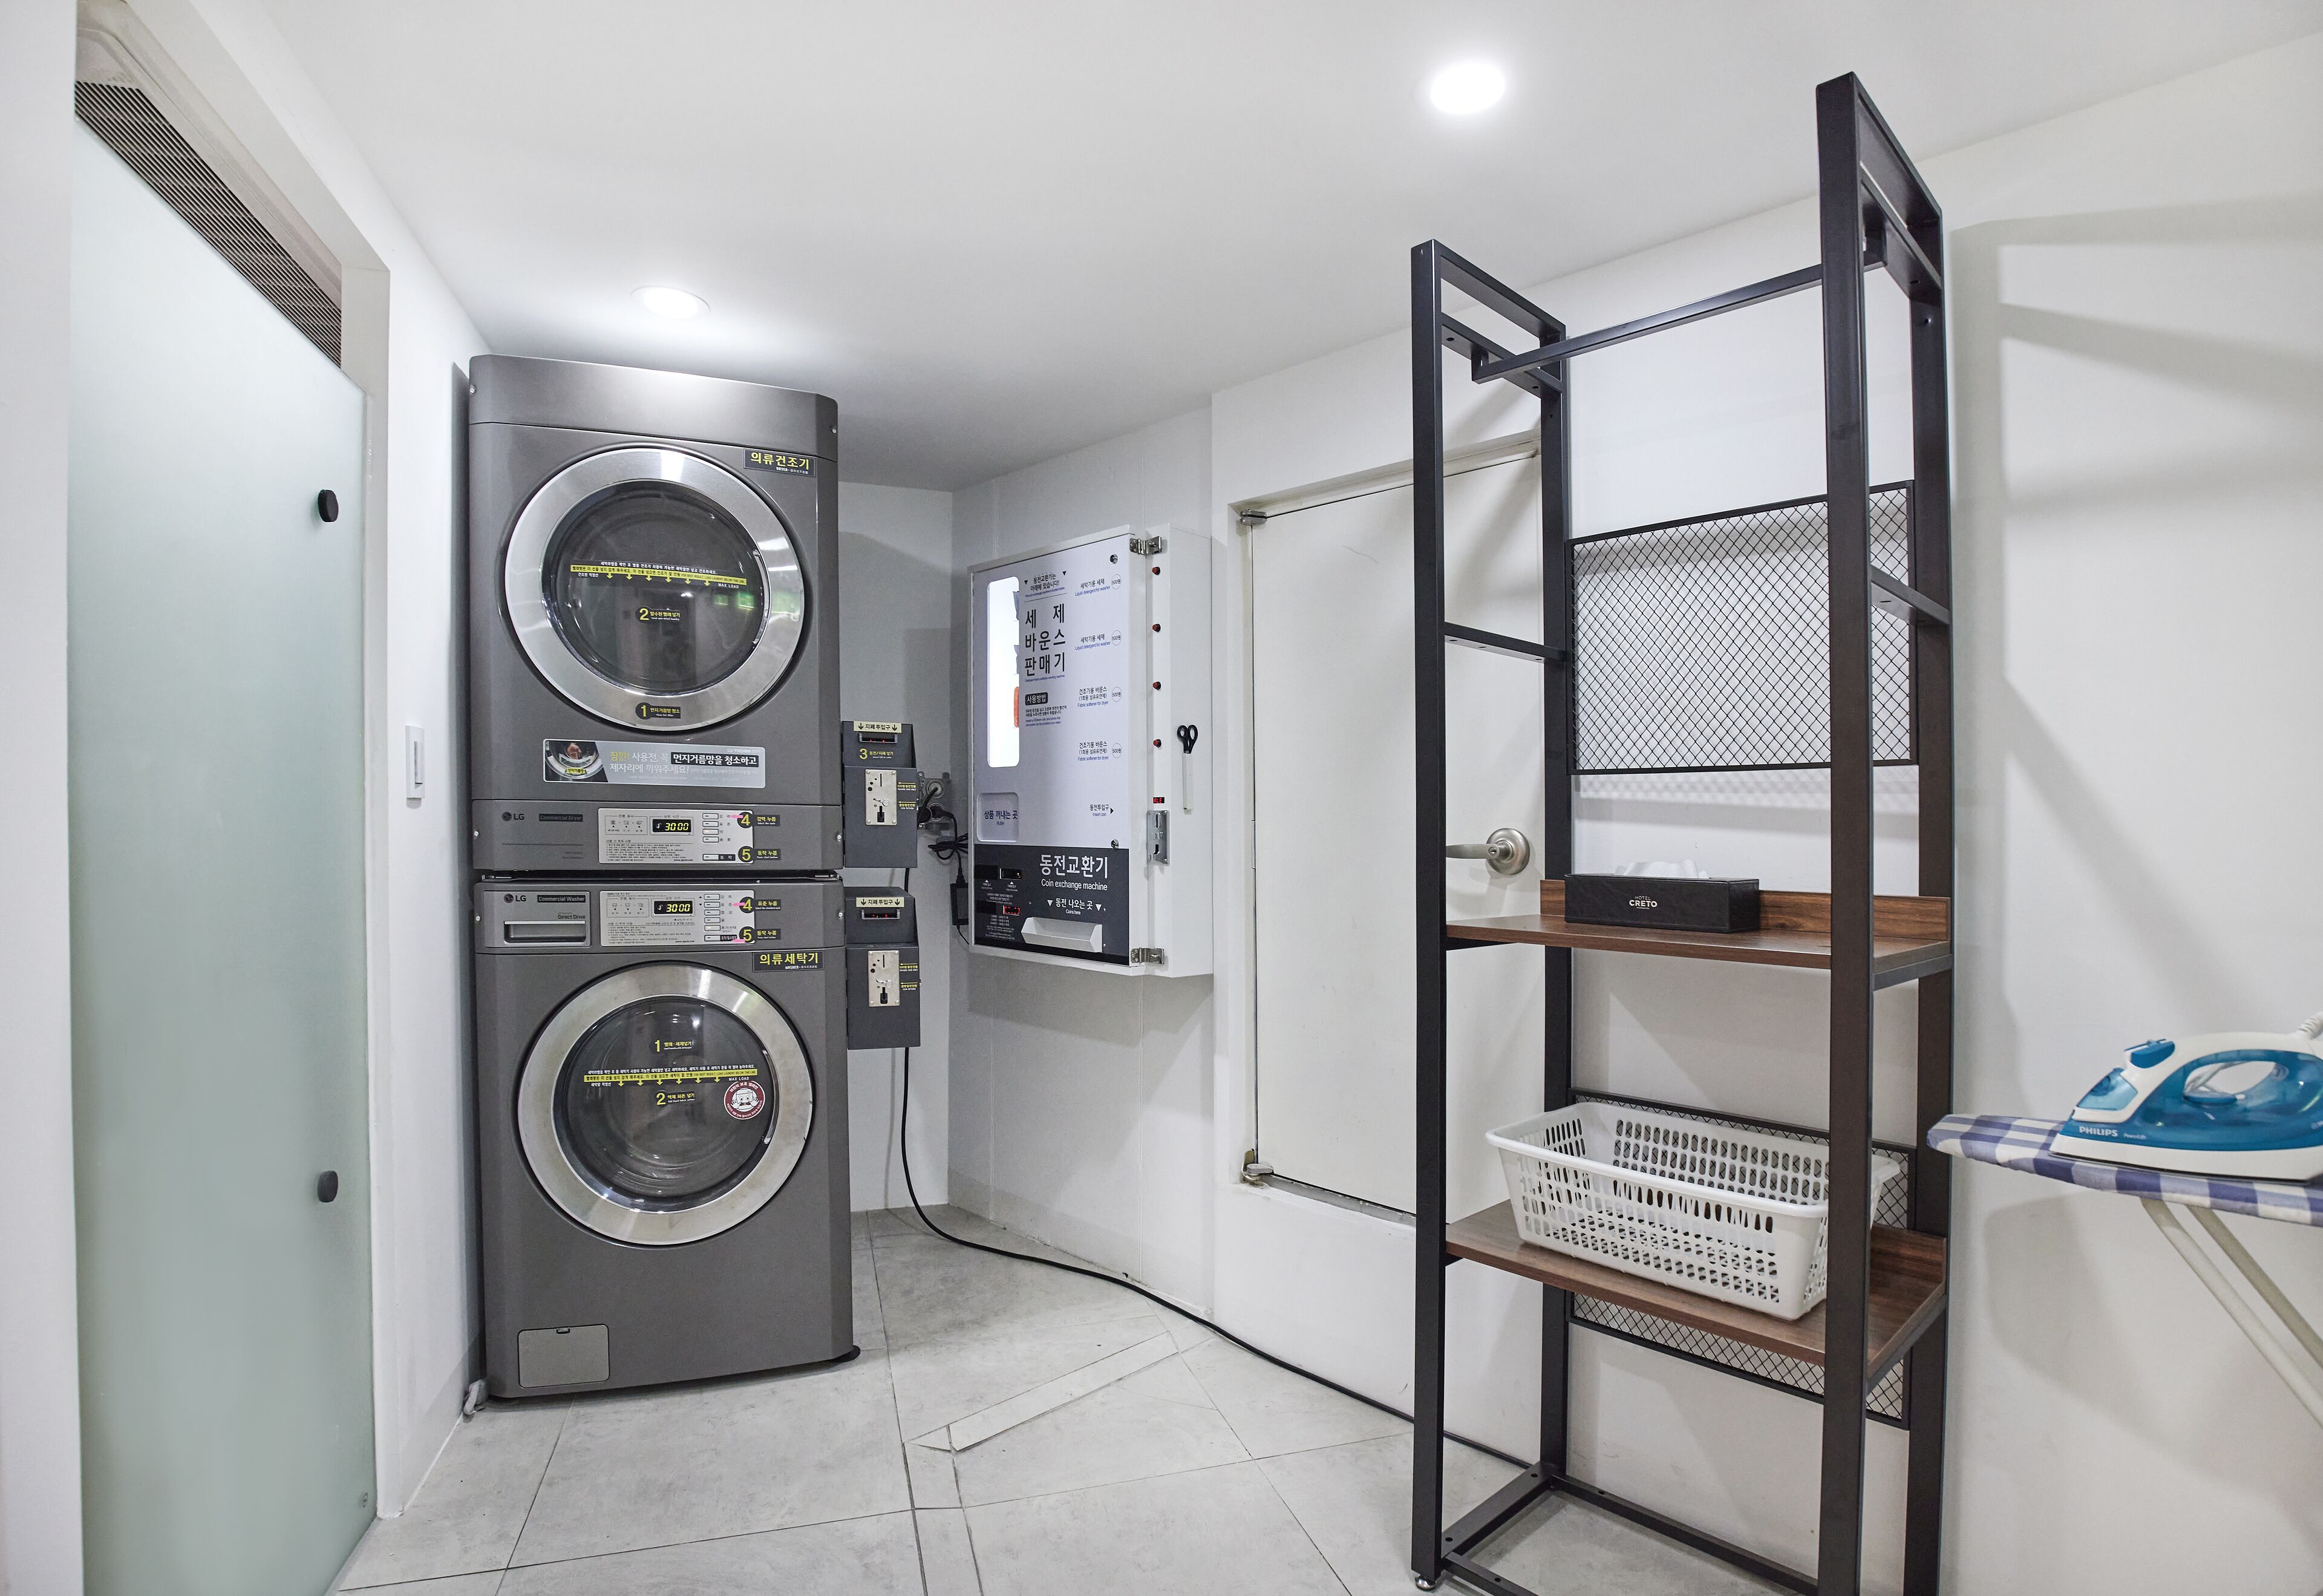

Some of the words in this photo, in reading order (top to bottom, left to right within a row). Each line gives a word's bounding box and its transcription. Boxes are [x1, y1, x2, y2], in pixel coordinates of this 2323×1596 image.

[1080, 580, 1096, 589] 세탁기용
[639, 608, 649, 620] 2
[1025, 629, 1065, 652] 바운스
[1025, 652, 1065, 676] 판매기
[1027, 695, 1046, 704] 사용방법
[641, 705, 646, 717] 1
[661, 753, 669, 762] 꼭
[673, 754, 722, 765] 먼지거름망을
[725, 756, 757, 765] 청소하고
[859, 748, 867, 759] 3
[610, 764, 644, 773] 제자리에
[646, 764, 689, 774] 끼워주세요!
[740, 814, 750, 826] 4
[984, 810, 995, 820] 상품
[996, 810, 1011, 820] 꺼내는
[1012, 811, 1018, 820] 곳
[742, 849, 751, 860] 5
[1040, 854, 1108, 878] 동전교환기
[1041, 878, 1054, 887] Coin
[1055, 880, 1082, 891] exchange
[1083, 882, 1108, 891] machine
[743, 899, 753, 911] 4
[1056, 898, 1067, 908] 동전
[1068, 899, 1085, 909] 나오는
[1086, 900, 1093, 910] 곳
[743, 929, 752, 941] 5
[655, 1040, 660, 1052] 1
[656, 1093, 666, 1105] 2
[2079, 1125, 2119, 1137] PHILIPS
